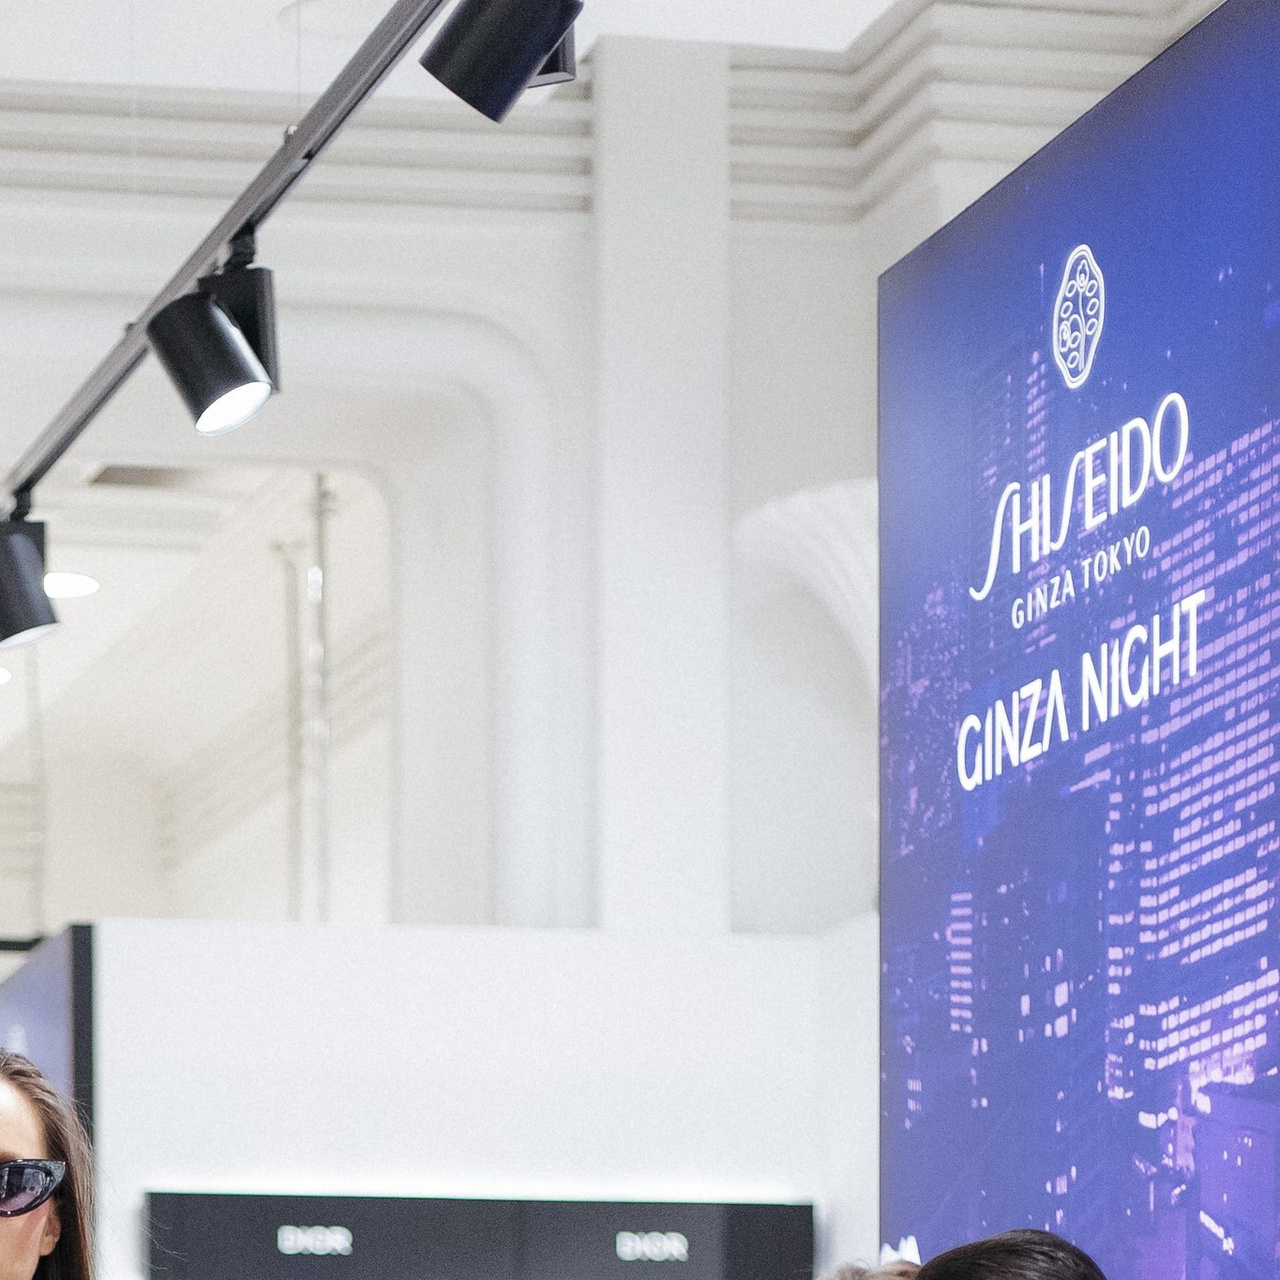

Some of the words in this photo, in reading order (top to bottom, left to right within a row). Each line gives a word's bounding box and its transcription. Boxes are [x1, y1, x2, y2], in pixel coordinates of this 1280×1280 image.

[968, 392, 1190, 601] SHISEIDO
[1011, 577, 1076, 630] GINZA
[1081, 525, 1151, 583] TOKYO
[956, 668, 1070, 792] GINZA
[1081, 589, 1207, 732] NIGHT
